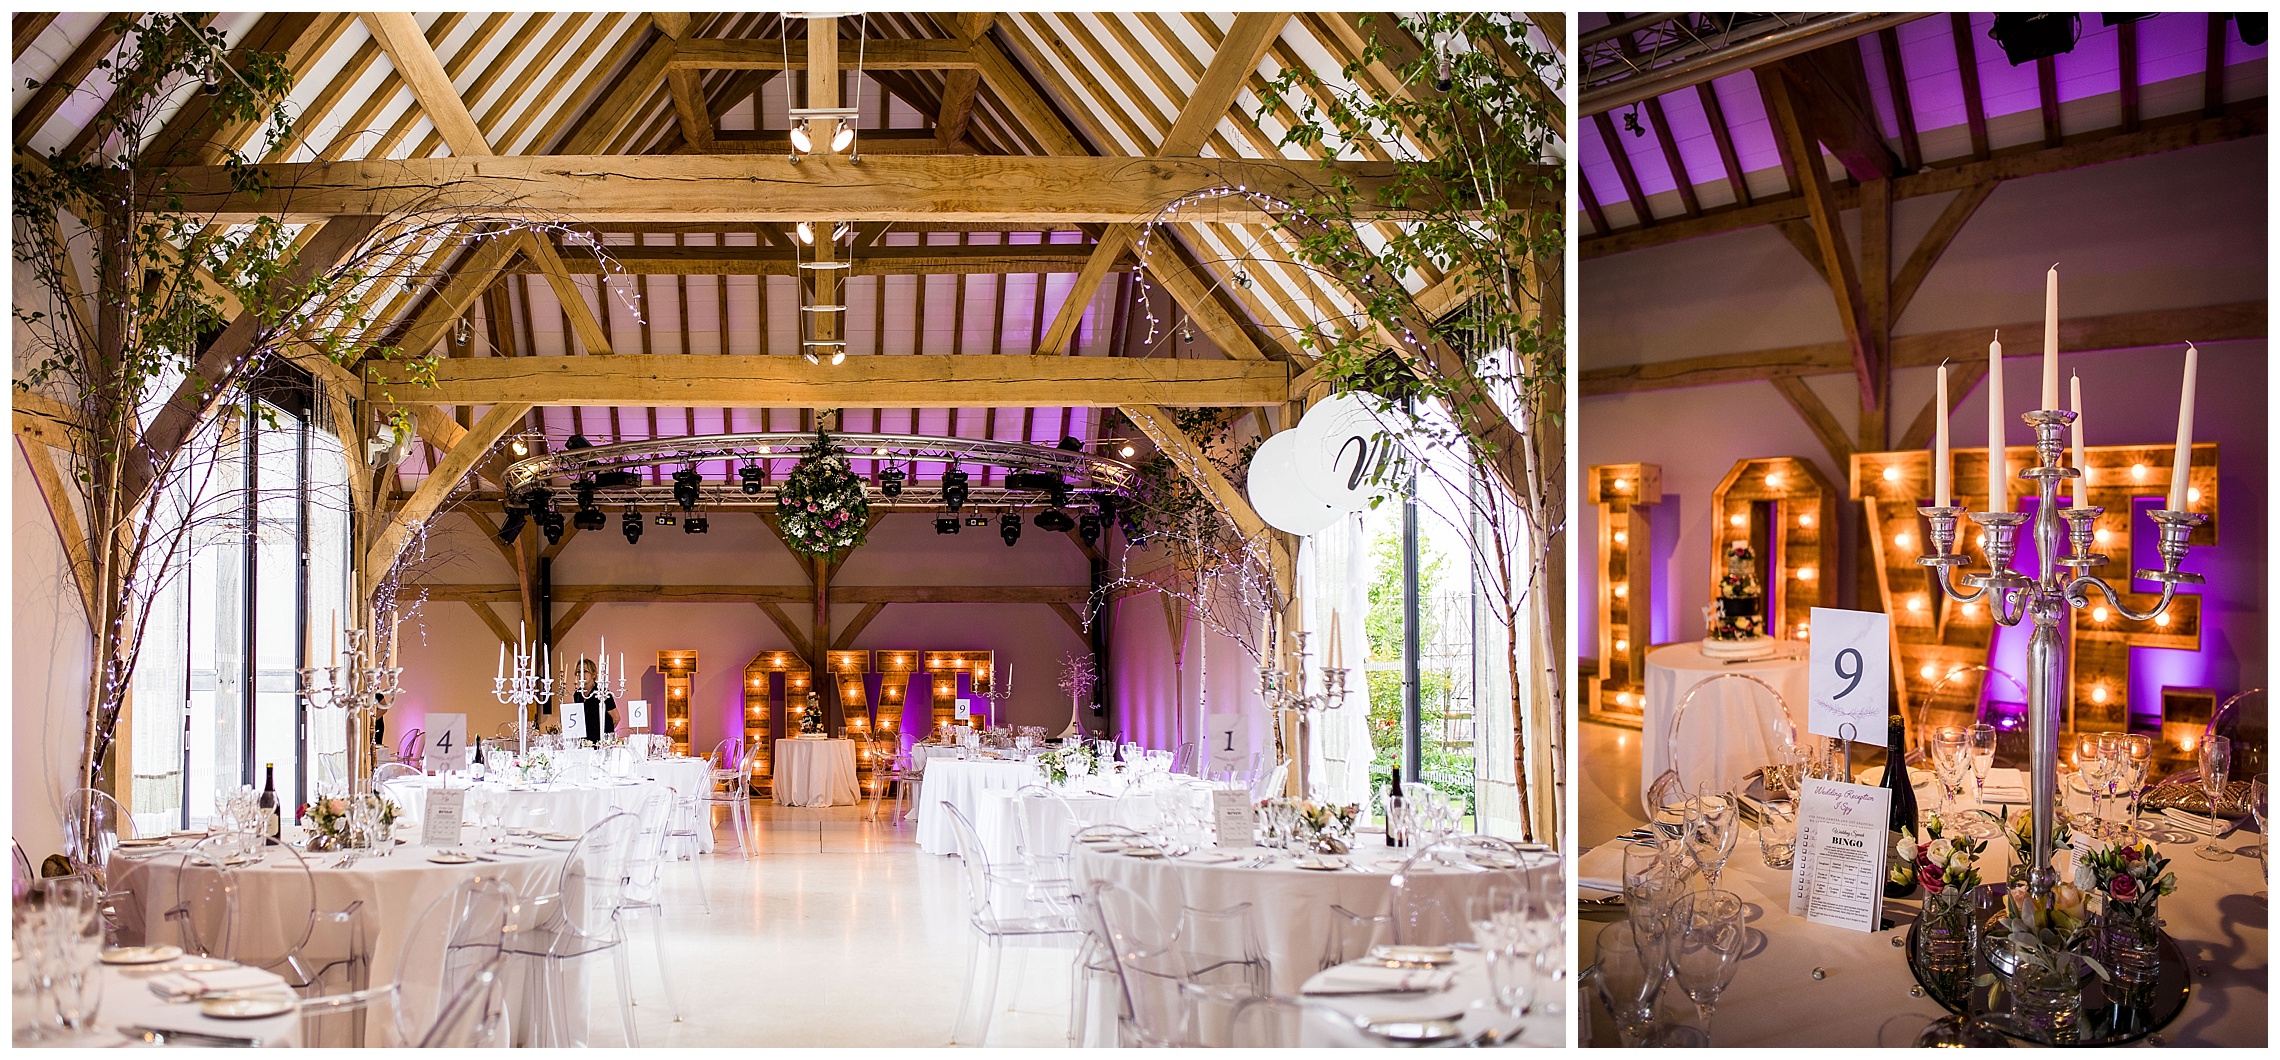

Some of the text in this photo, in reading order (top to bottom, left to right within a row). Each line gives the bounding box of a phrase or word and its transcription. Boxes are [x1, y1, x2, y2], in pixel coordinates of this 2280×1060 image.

[1832, 647, 1864, 701] 9
[634, 706, 642, 718] 6
[959, 704, 966, 714] 9
[568, 712, 578, 729] 5
[436, 729, 453, 754] 4
[1224, 730, 1235, 752] 1
[1814, 785, 1875, 804] Wedding Reception
[1840, 802, 1853, 816] Spy
[1831, 826, 1851, 838] Wedding
[1832, 836, 1864, 848] BINGO
